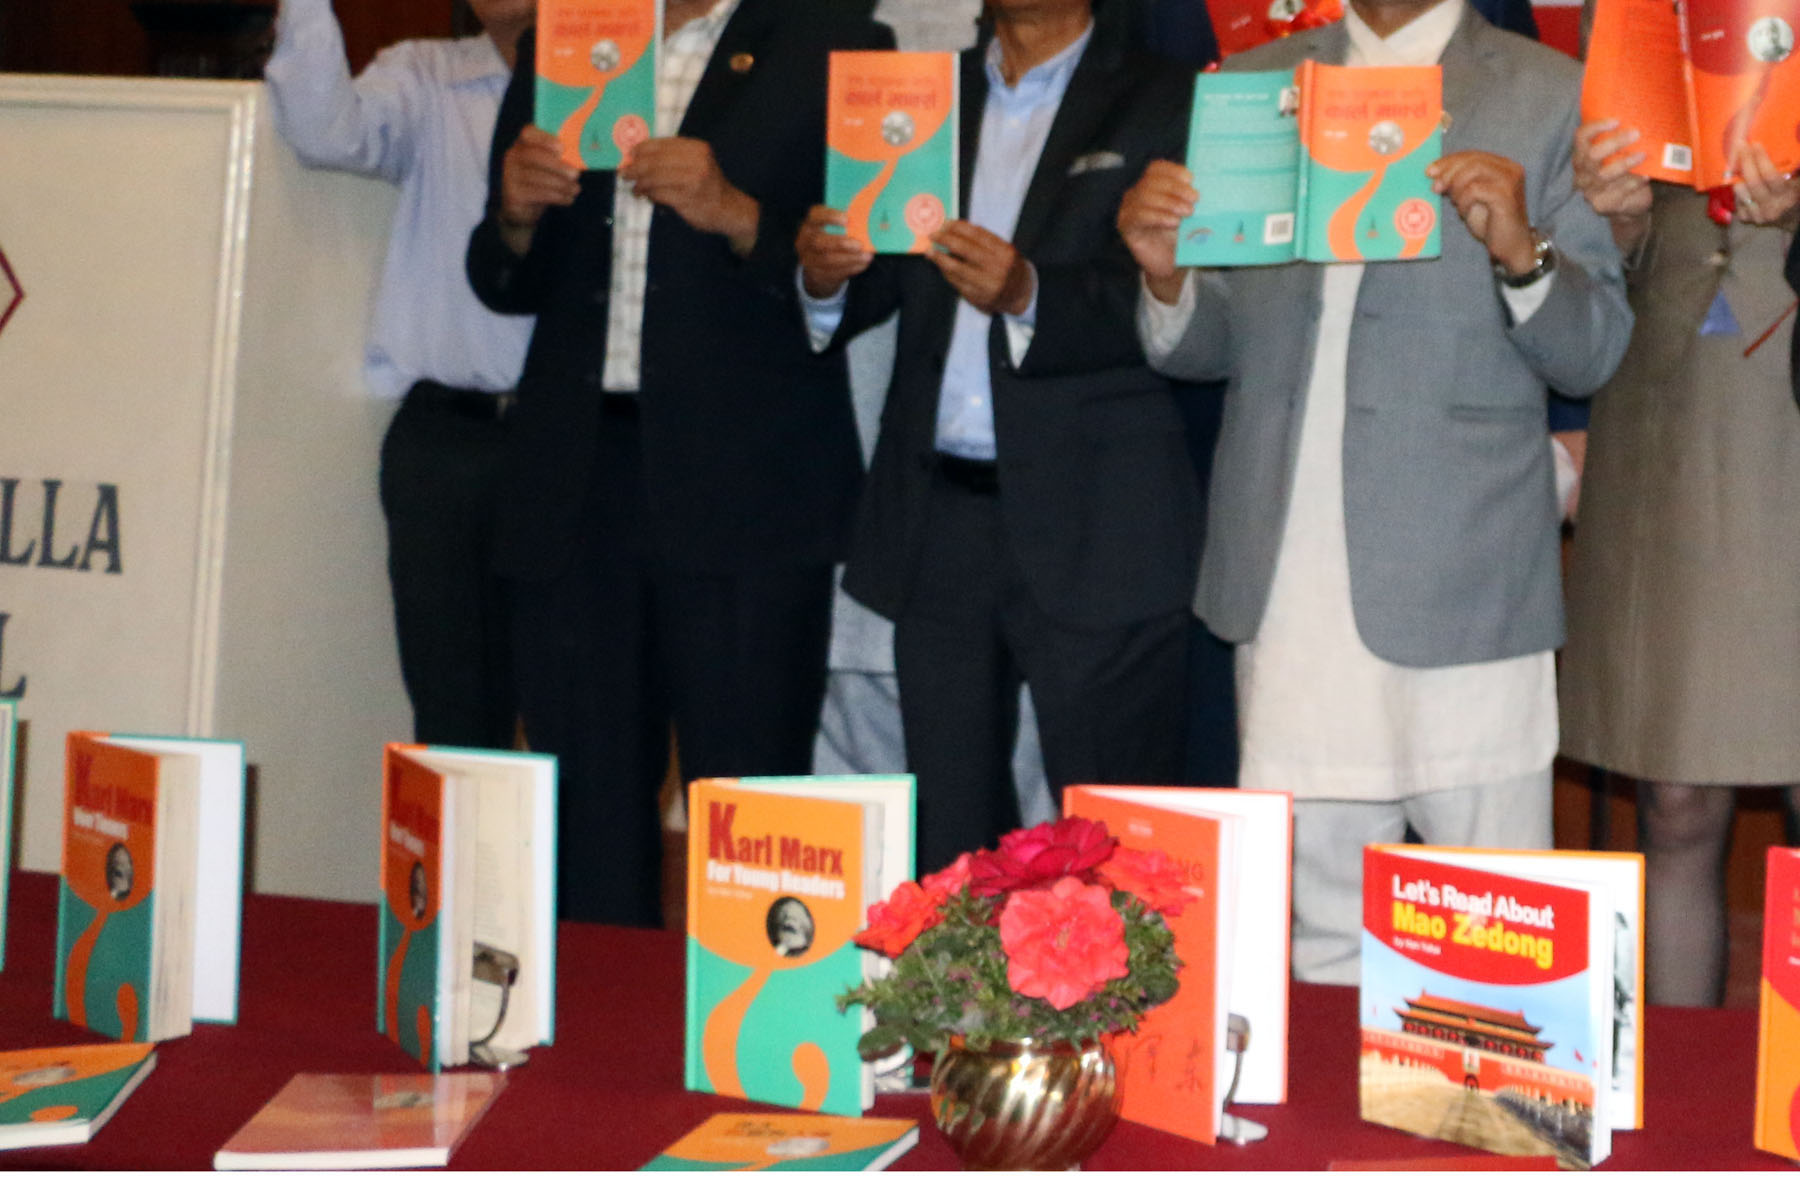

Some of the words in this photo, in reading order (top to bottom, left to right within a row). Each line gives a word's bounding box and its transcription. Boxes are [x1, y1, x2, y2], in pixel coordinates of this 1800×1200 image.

[708, 801, 773, 867] Karl
[780, 836, 844, 877] Marx
[706, 859, 732, 883] For
[733, 863, 780, 892] Young
[1392, 873, 1441, 906] Let's
[1441, 883, 1493, 917] Read
[1494, 894, 1556, 930] About
[1392, 899, 1447, 940] Mao
[1451, 912, 1555, 970] Zedong
